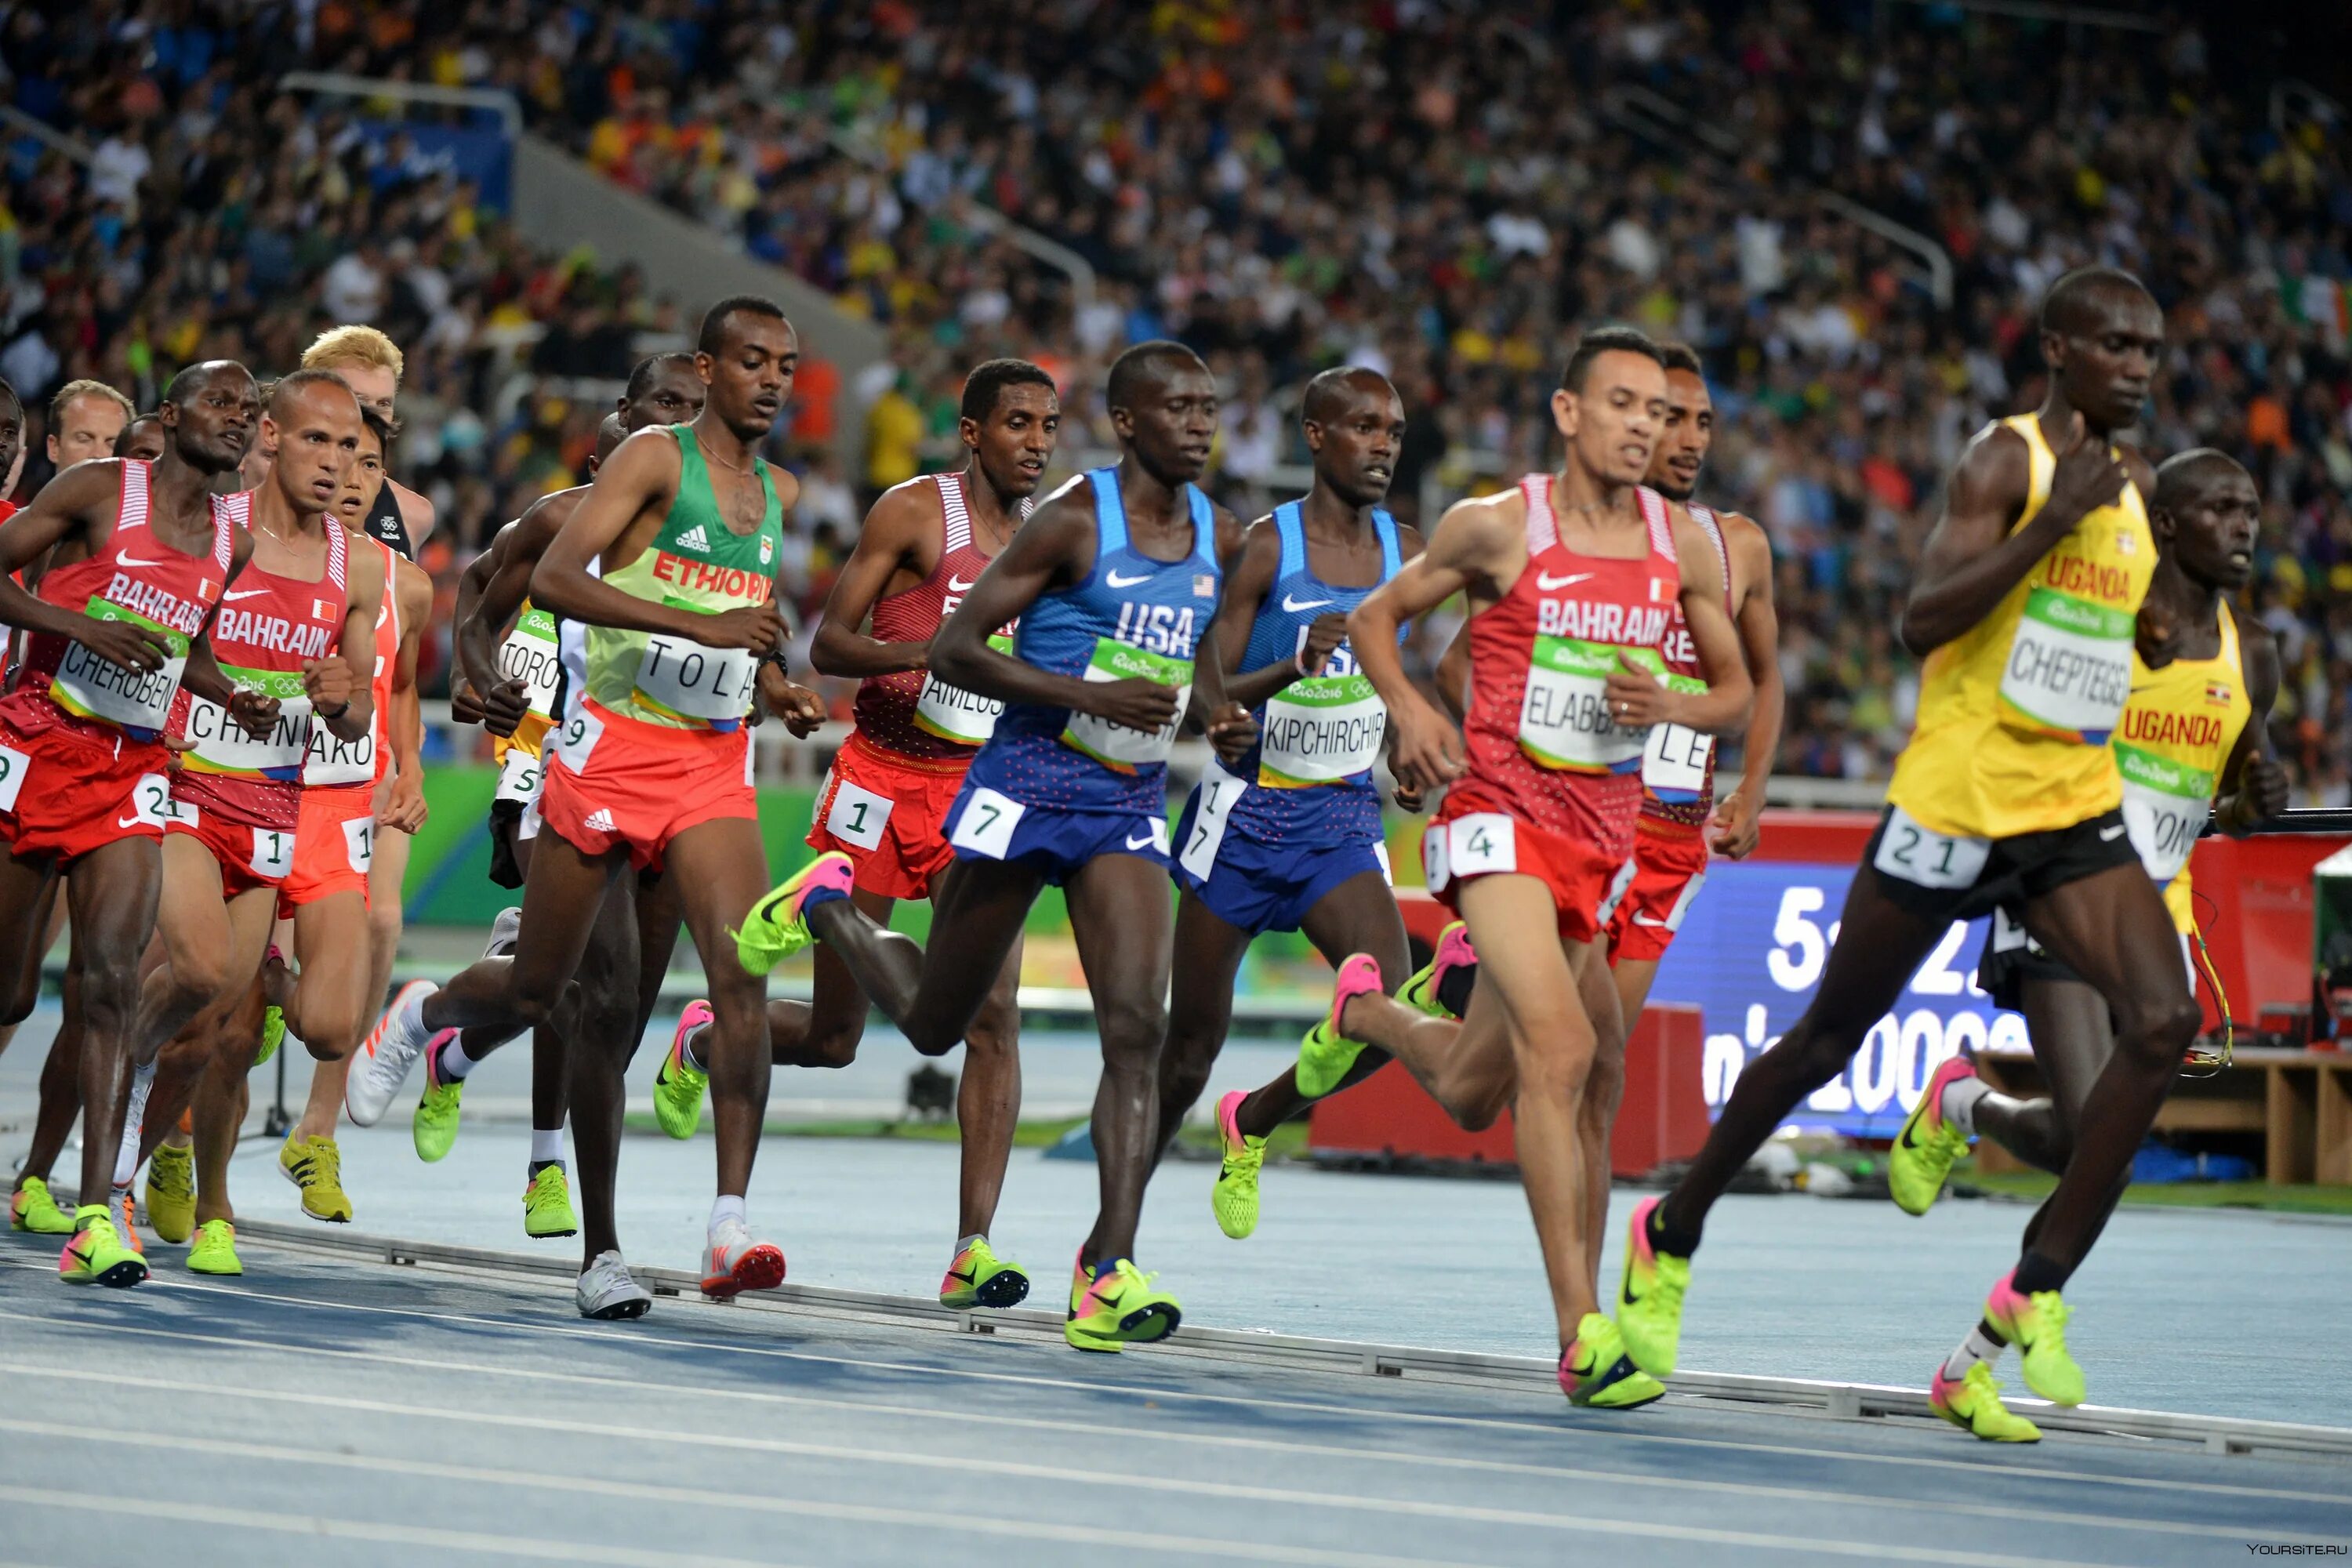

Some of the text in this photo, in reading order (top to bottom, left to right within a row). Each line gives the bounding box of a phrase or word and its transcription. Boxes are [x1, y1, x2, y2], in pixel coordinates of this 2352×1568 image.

[676, 537, 711, 554] adidas
[2047, 553, 2131, 603] UGANDA
[104, 572, 209, 638] BAHRAIN
[1537, 597, 1670, 645] BAHRAIN
[216, 608, 331, 659] BAHRAIN
[1114, 601, 1195, 658] USA
[503, 643, 558, 689] TORO
[648, 640, 753, 700] TOLA
[1287, 680, 1343, 699] Rio2016
[565, 719, 586, 746] 9
[1265, 712, 1385, 755] KIPCHIRCHIR
[2124, 706, 2222, 750] UGANDA
[846, 802, 869, 833] 1
[982, 804, 1002, 836] 7
[267, 833, 281, 864] 1
[1468, 826, 1494, 857] 4
[1893, 825, 1955, 877] 21
